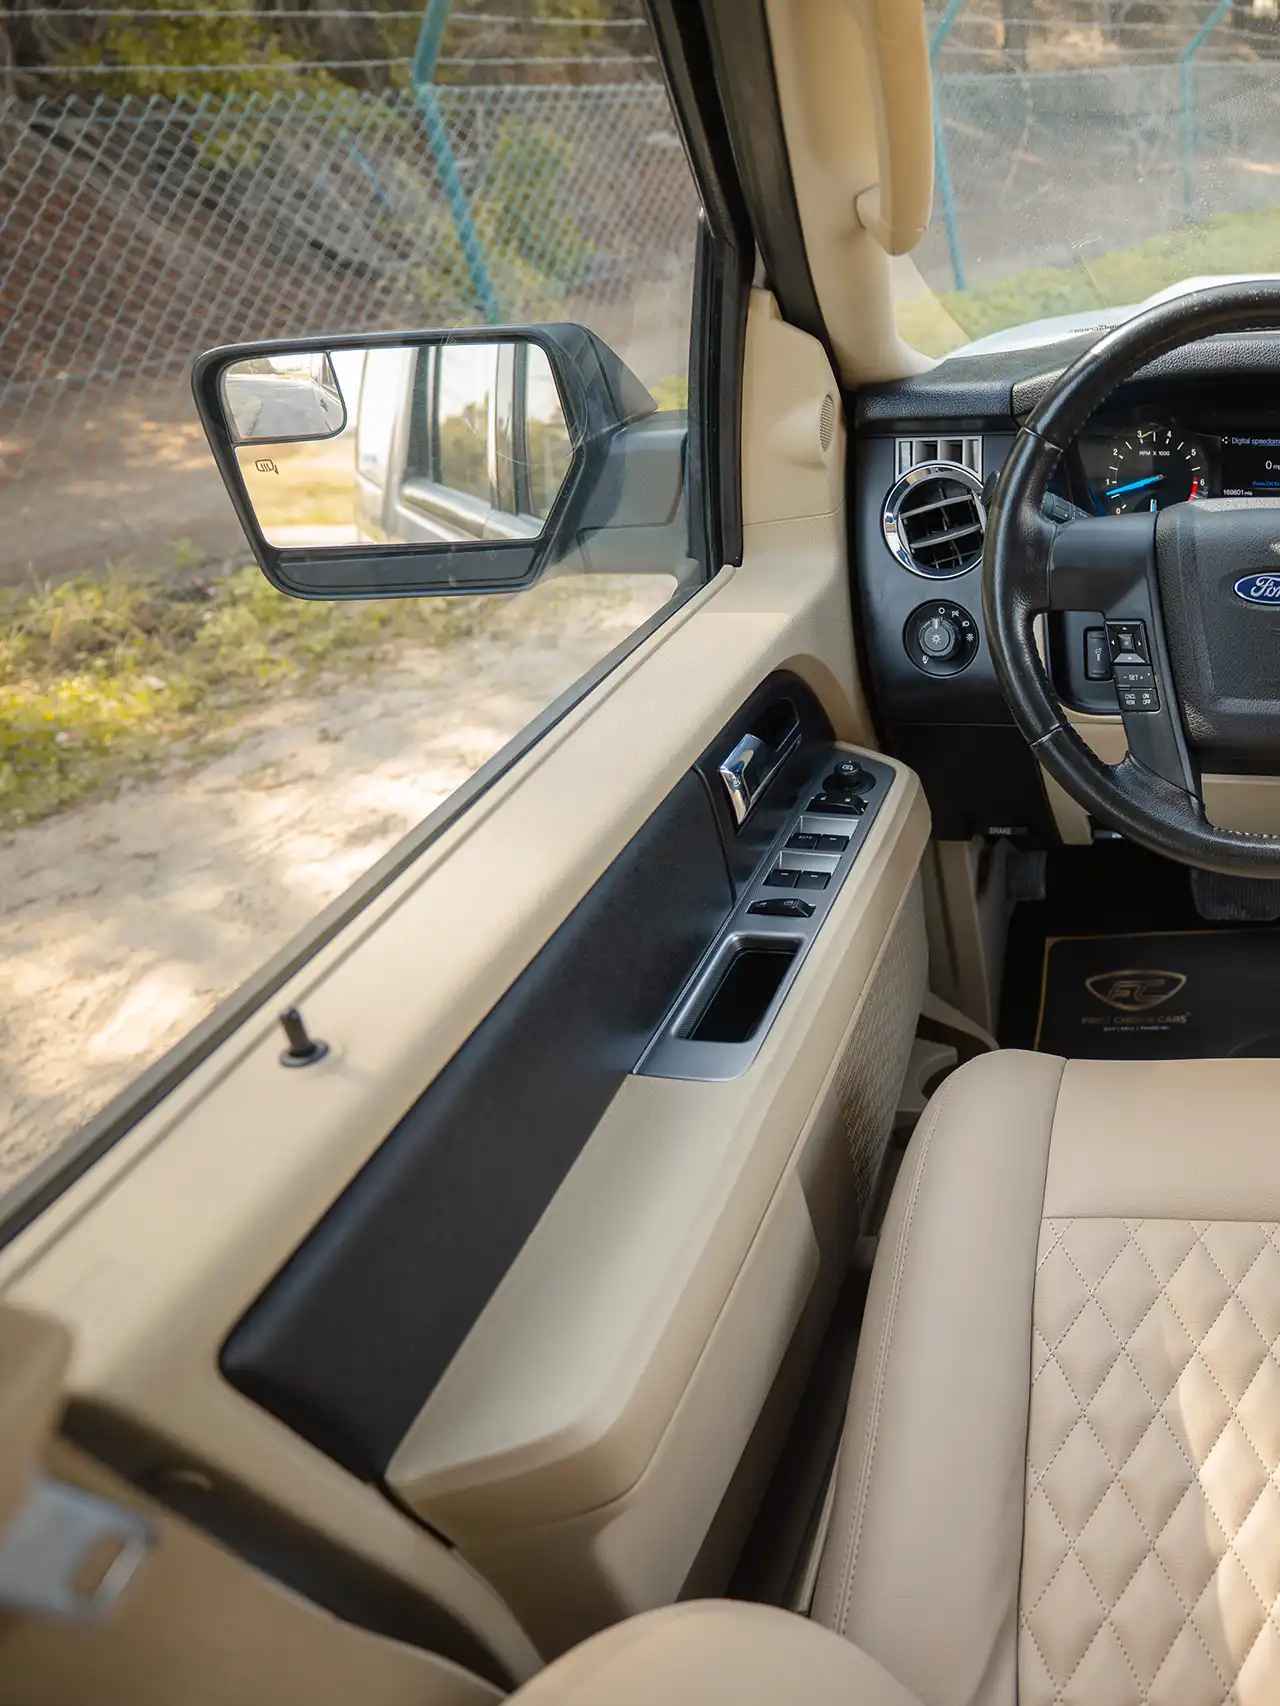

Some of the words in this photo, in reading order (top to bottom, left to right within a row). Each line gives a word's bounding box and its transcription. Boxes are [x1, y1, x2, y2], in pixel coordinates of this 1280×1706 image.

[1137, 430, 1142, 438] 3
[1167, 430, 1172, 438] 4
[1231, 437, 1251, 445] Digital
[1113, 448, 1118, 456] 2
[1191, 448, 1196, 456] 5
[1265, 460, 1272, 470] 0
[990, 826, 1012, 835] BRAKE
[1157, 1014, 1188, 1024] CARS
